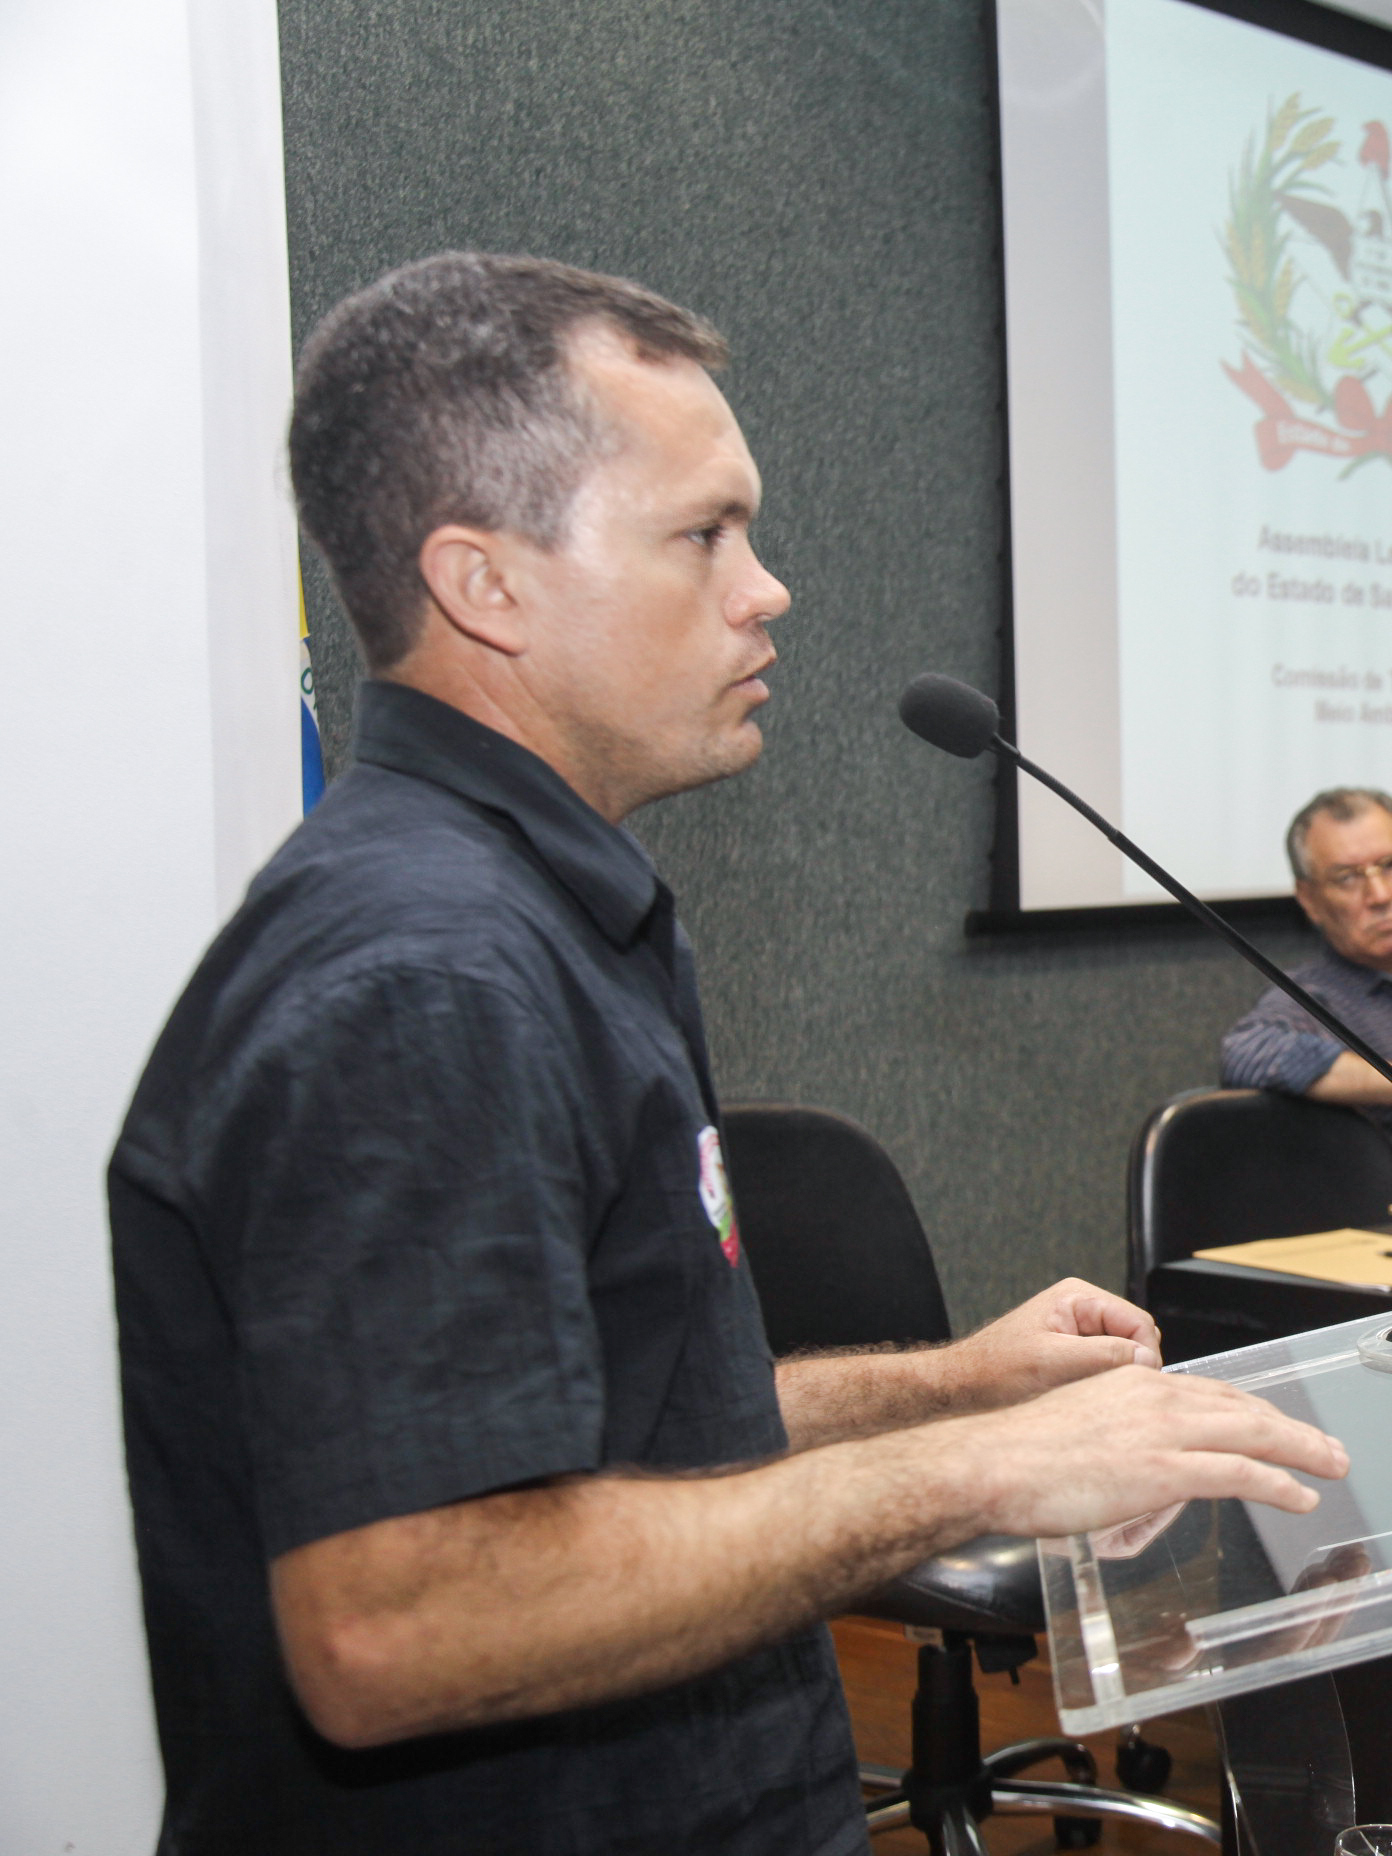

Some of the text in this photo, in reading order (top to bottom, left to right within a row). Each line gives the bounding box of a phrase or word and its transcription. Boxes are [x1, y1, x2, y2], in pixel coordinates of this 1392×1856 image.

[1232, 571, 1261, 597] do
[1267, 571, 1335, 604] Estado
[1342, 582, 1364, 606] de
[1363, 669, 1383, 691] de
